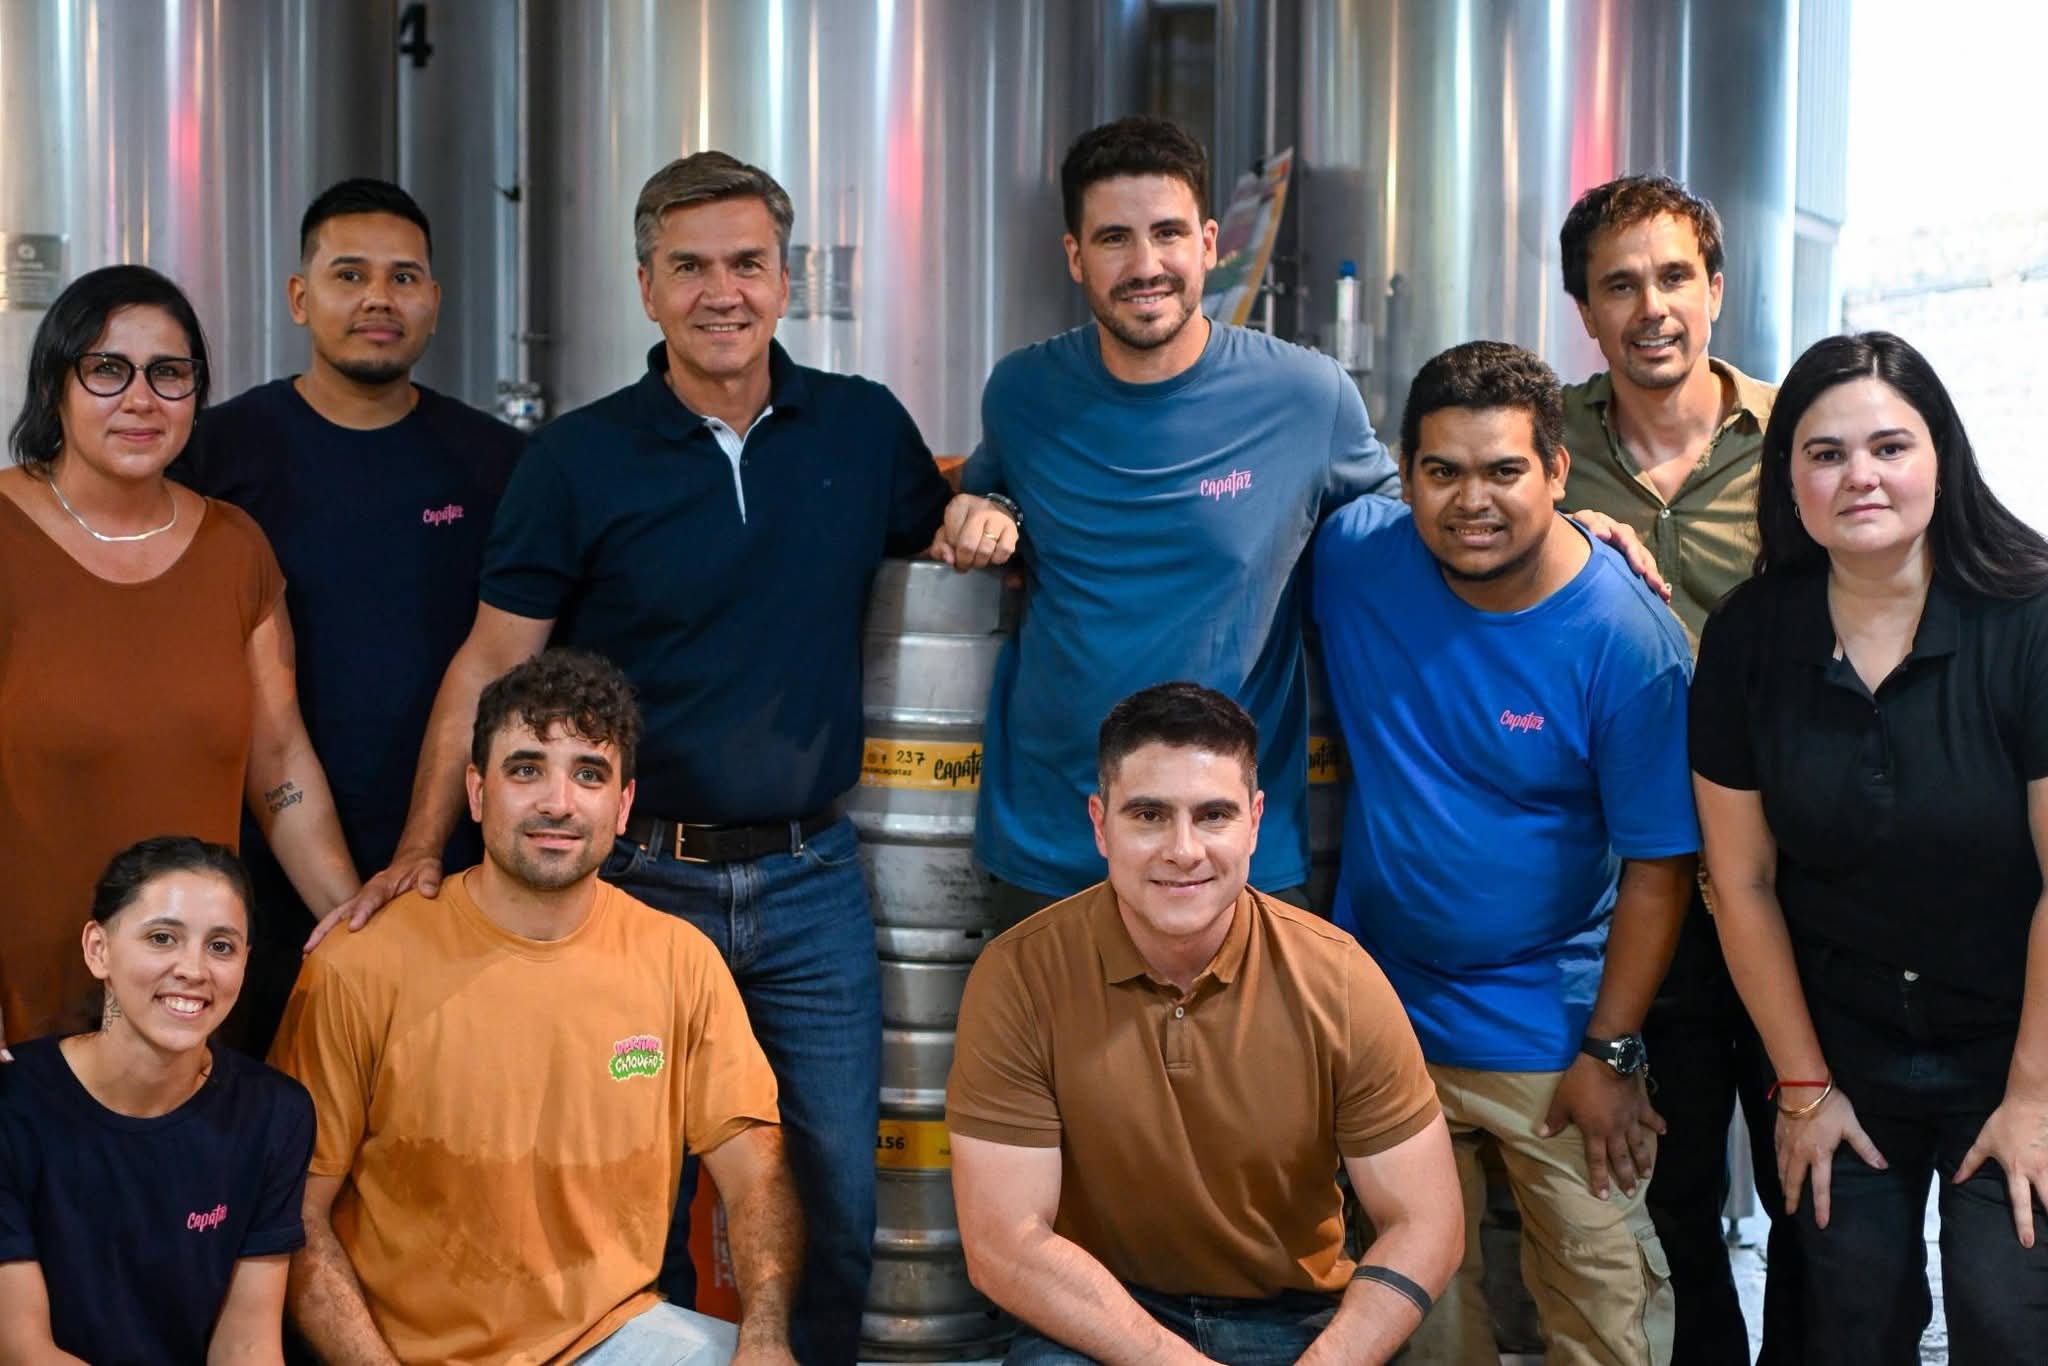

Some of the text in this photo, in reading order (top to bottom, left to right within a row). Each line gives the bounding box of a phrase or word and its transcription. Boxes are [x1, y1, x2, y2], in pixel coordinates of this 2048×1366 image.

[399, 3, 434, 68] 4
[1200, 468, 1252, 501] Capataz
[896, 750, 926, 766] 237
[933, 749, 984, 786] Capata
[269, 789, 303, 814] today
[876, 1136, 905, 1150] 156
